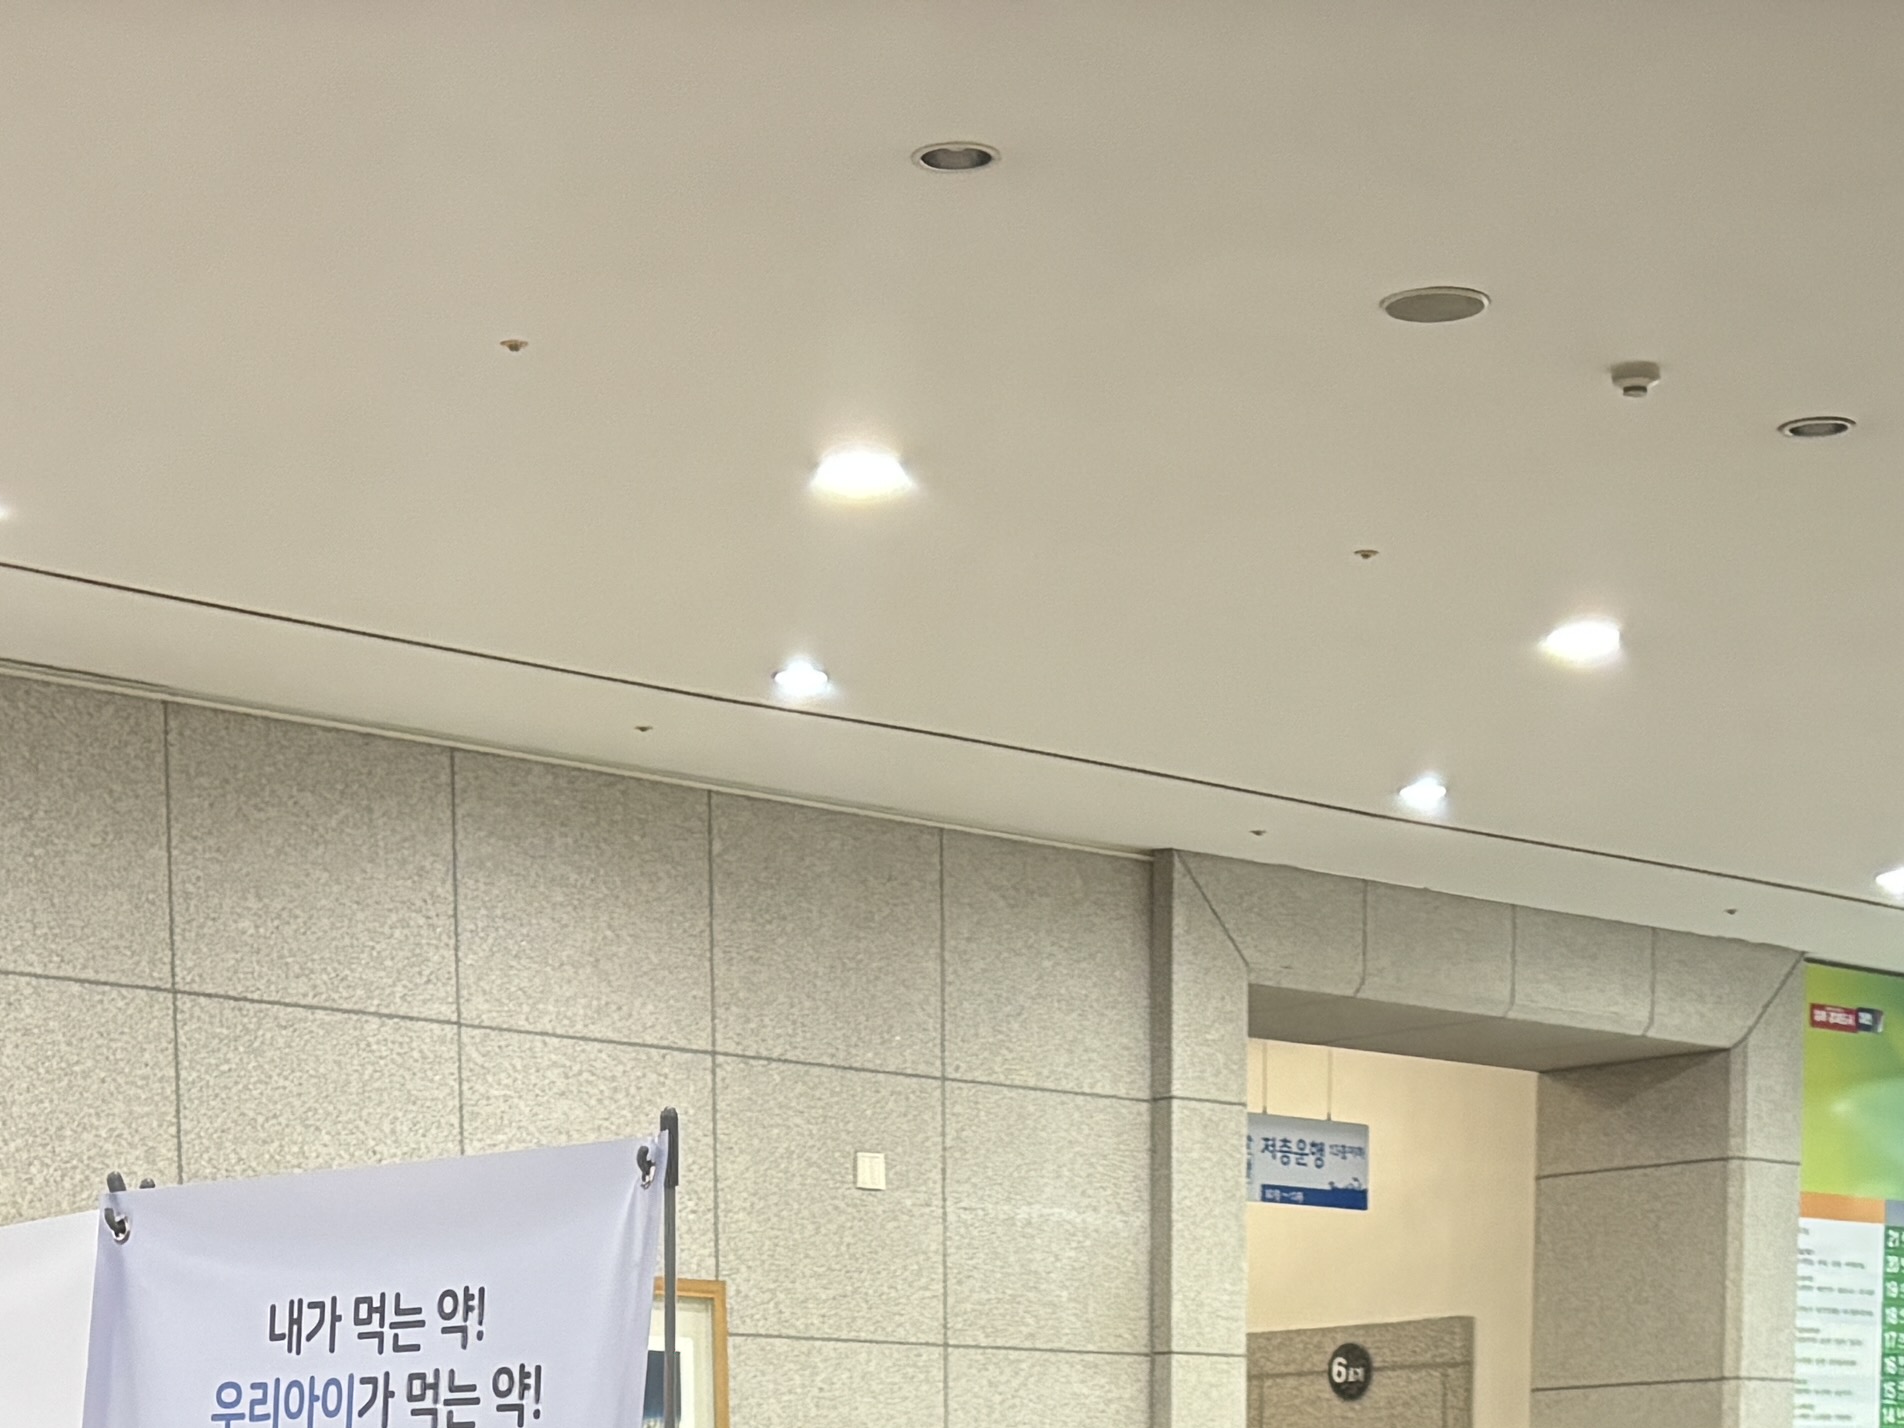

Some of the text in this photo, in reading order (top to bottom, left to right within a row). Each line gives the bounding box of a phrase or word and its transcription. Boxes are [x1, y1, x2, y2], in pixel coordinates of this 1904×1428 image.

[1261, 1137, 1325, 1169] 저층운행
[268, 1285, 486, 1355] 내가 먹는 약!
[491, 1362, 543, 1428] 약!
